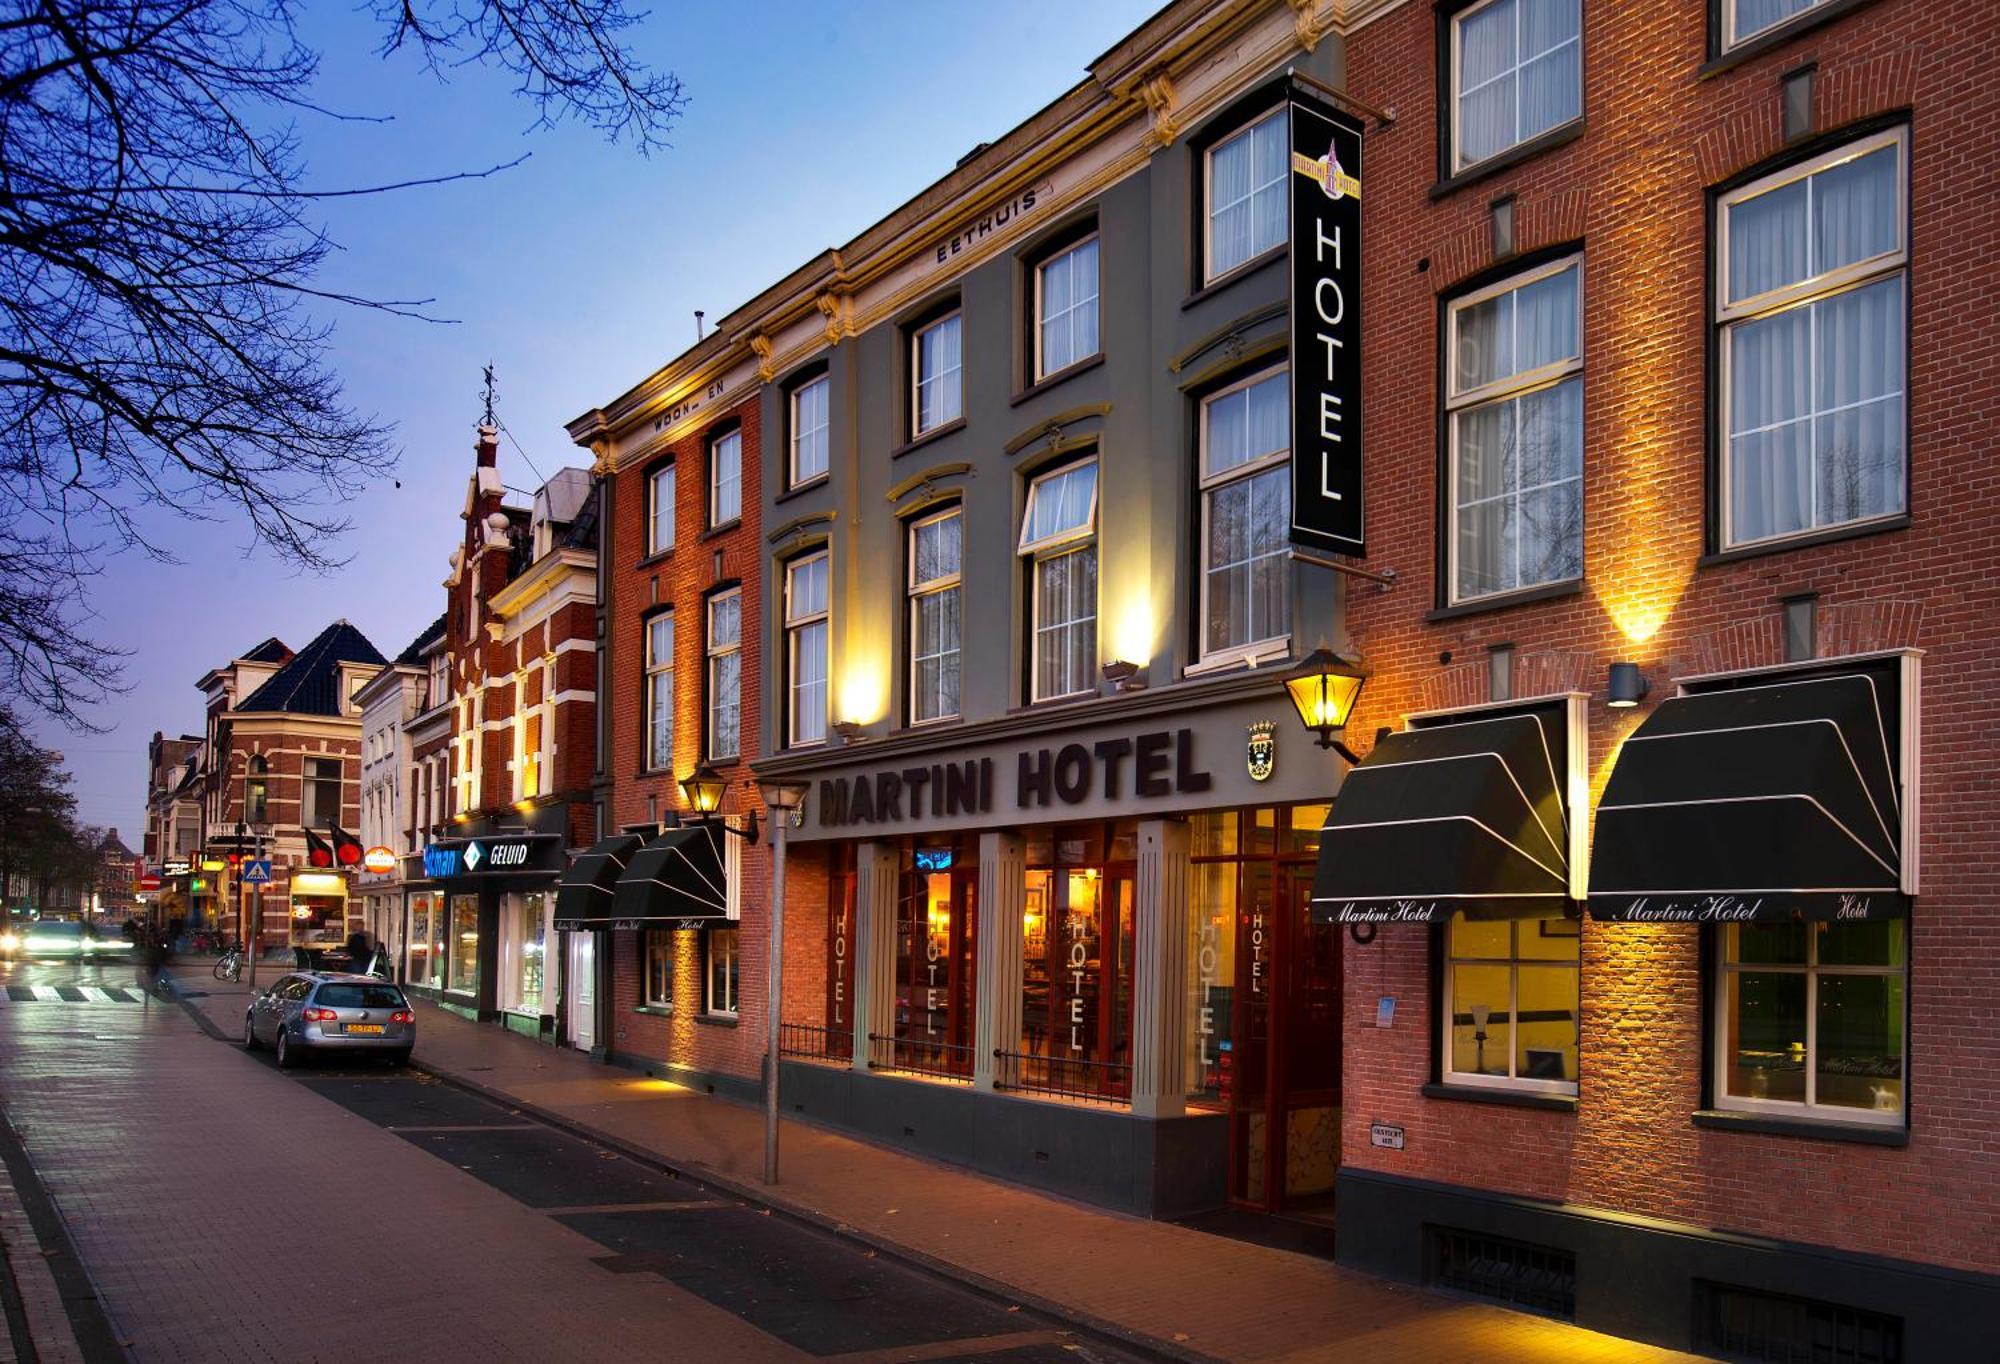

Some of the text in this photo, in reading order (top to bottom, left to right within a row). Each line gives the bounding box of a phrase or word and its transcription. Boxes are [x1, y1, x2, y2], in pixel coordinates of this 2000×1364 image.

[937, 190, 1036, 263] EETHUIS
[708, 380, 723, 399] EN
[1315, 217, 1343, 500] HOTEL
[818, 728, 1211, 827] MARTINI HOTEL
[490, 844, 528, 865] GELUID
[1328, 900, 1436, 922] Martini Hotel
[1612, 896, 1763, 921] Martini Hotel
[1837, 894, 1871, 920] Hotel
[835, 915, 847, 1023] HOTEL
[1252, 914, 1262, 992] HOTEL
[1200, 917, 1216, 1065] HOTEL
